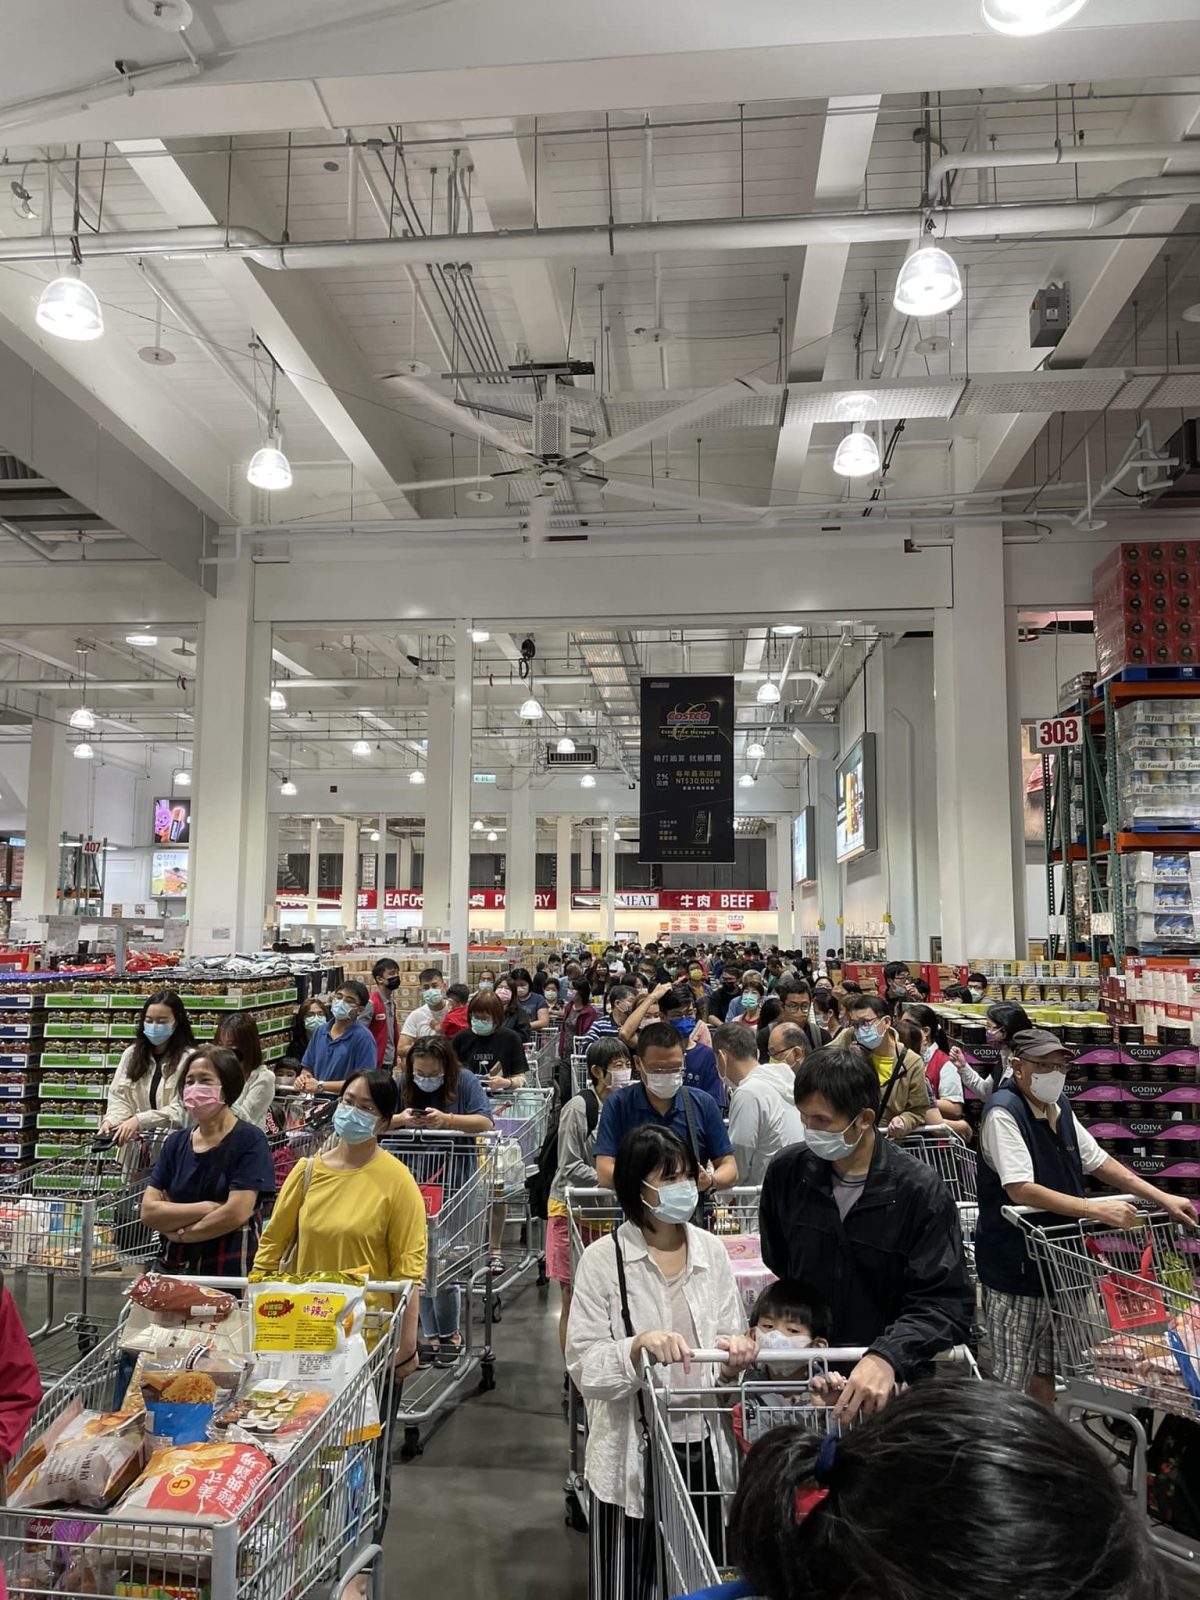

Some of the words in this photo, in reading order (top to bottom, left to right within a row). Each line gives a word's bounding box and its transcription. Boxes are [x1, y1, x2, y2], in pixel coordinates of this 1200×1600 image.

[667, 711, 711, 721] COSTCO
[1040, 719, 1078, 745] 303
[84, 842, 101, 853] 407
[680, 894, 711, 908] 牛肉
[721, 894, 755, 908] BEEF
[1130, 1048, 1161, 1056] GODIVA
[1063, 1085, 1083, 1093] DIVA
[1131, 1085, 1163, 1094] GODIVA
[1130, 1123, 1162, 1131] GODIVA
[1132, 1160, 1165, 1169] GODIVA
[249, 1462, 268, 1492] Breast
[171, 1479, 191, 1489] CP
[197, 1471, 226, 1501] 美式
